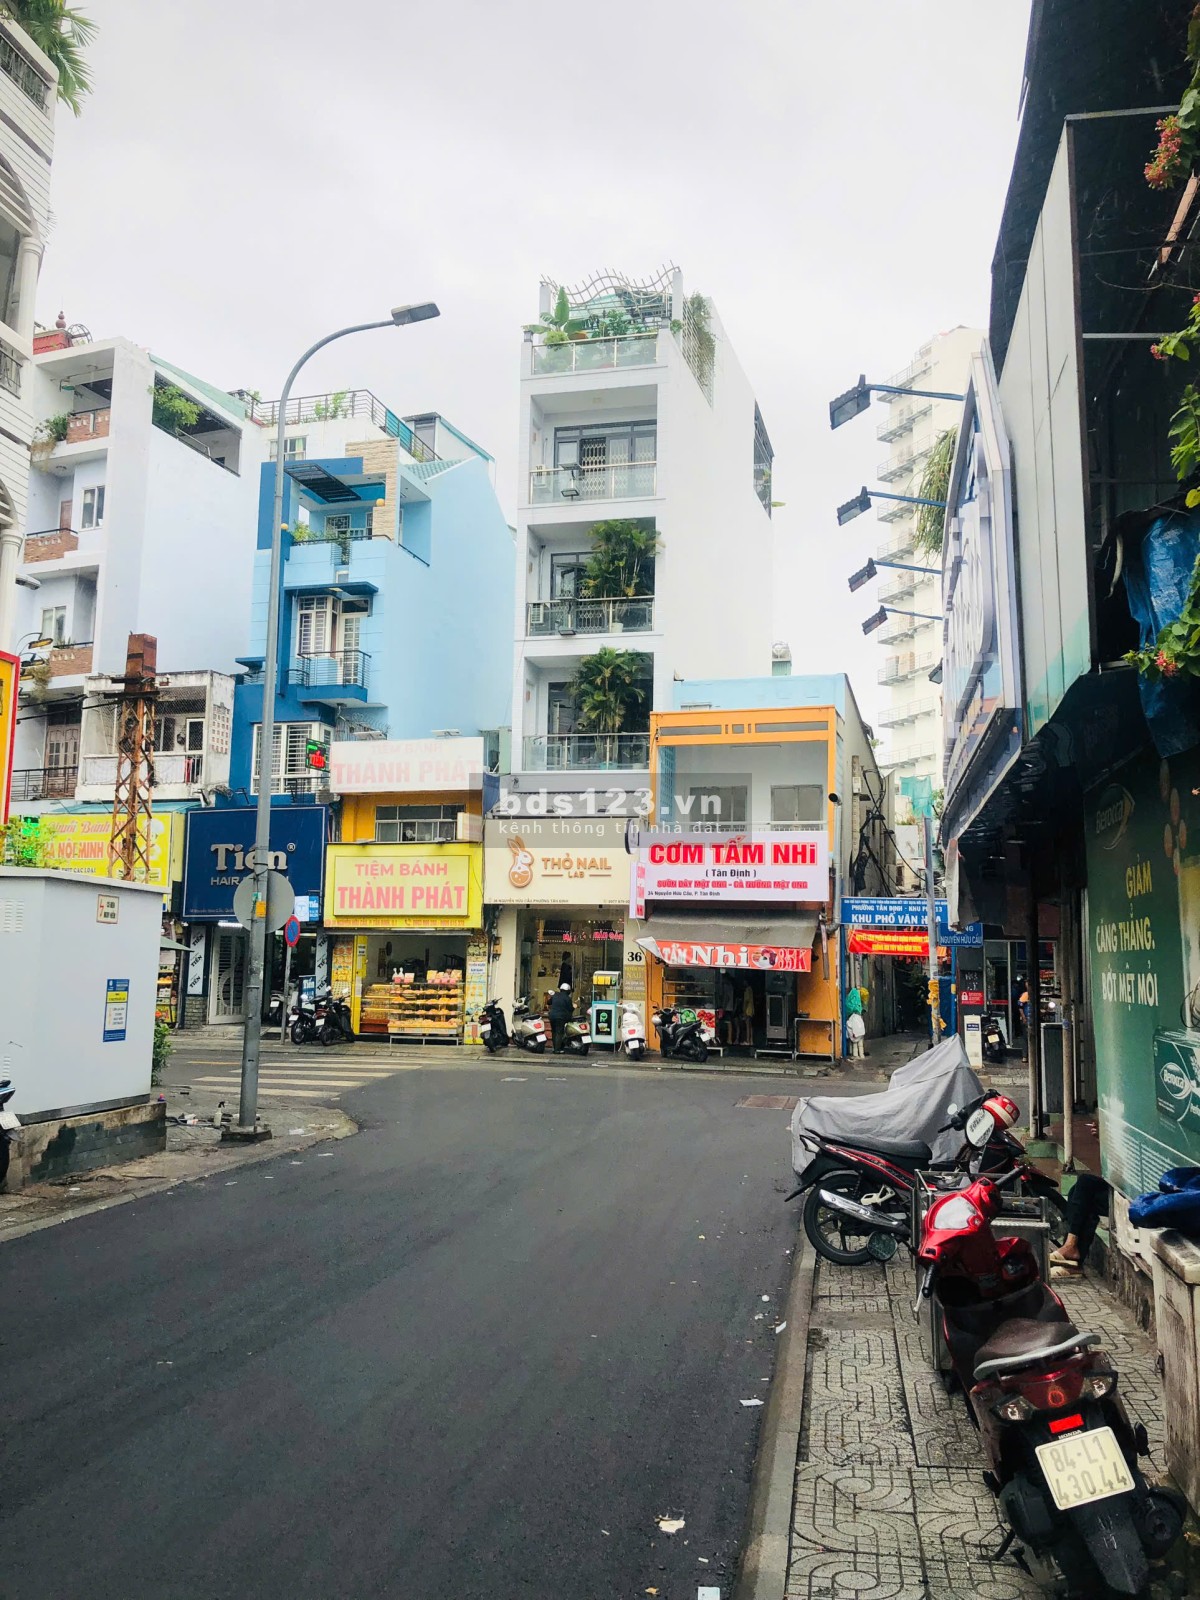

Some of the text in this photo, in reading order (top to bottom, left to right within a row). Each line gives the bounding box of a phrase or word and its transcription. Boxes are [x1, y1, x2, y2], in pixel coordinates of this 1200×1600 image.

[333, 755, 481, 785] THÀNH PHÁT
[650, 840, 704, 865] CƠM
[711, 835, 766, 865] TẤM
[355, 859, 448, 880] TIỆM BÁNH
[541, 852, 612, 870] THỎ NAIL
[568, 871, 585, 879] LAB
[711, 869, 728, 877] Tân
[730, 868, 751, 879] Định
[1125, 853, 1153, 899] GIẢM
[338, 880, 465, 909] THÀNH PHÁT
[851, 904, 875, 912] PHƯỜNG
[876, 904, 888, 912] TÂN
[889, 906, 903, 914] ĐỊNH
[851, 911, 942, 925] KHU PHỐ VĂN HA
[940, 933, 961, 944] NGUYỄN
[1096, 917, 1118, 953] CĂNG
[627, 951, 642, 962] 36
[662, 943, 687, 965] TẤM
[690, 945, 750, 966] Nhi
[1101, 959, 1159, 1011] BỚT MỆT MỎI
[1163, 1069, 1185, 1089] Berocca
[1058, 1429, 1083, 1440] HONDA
[1055, 1461, 1128, 1503] 430.44
